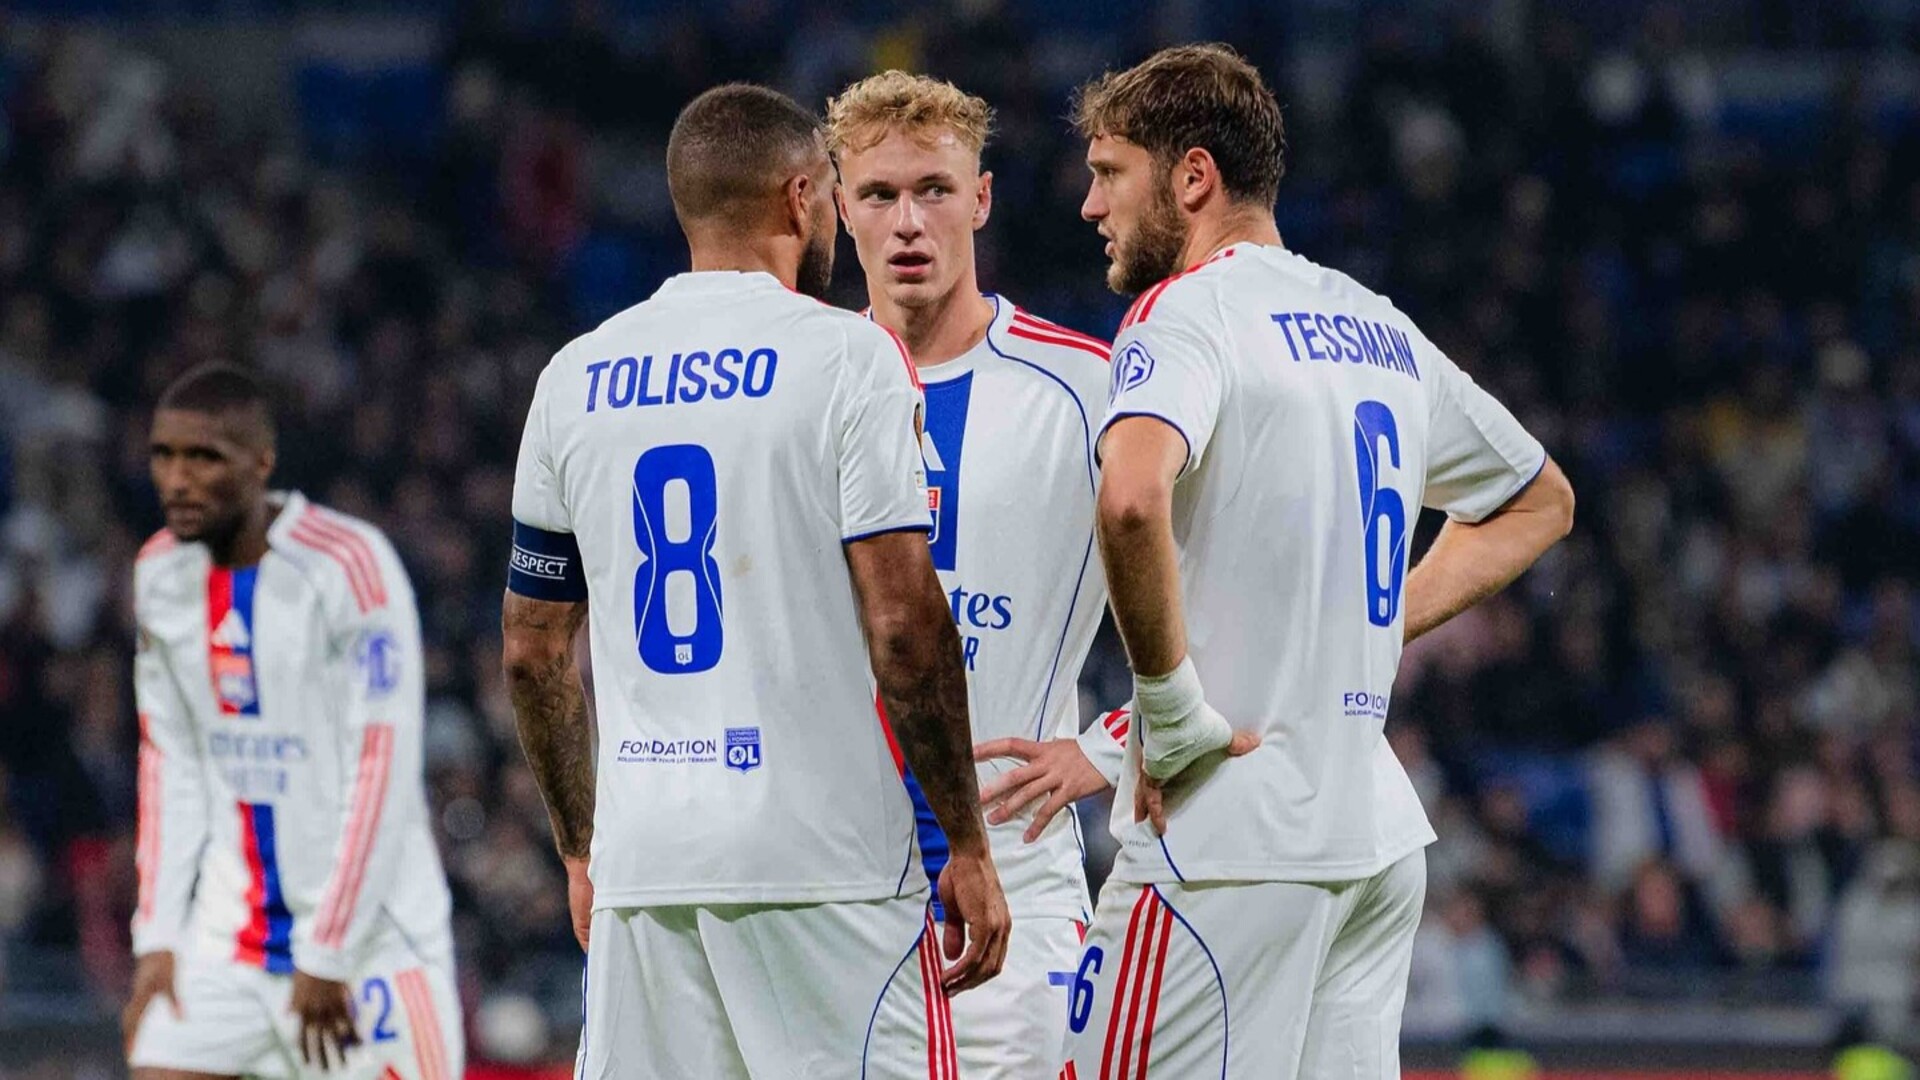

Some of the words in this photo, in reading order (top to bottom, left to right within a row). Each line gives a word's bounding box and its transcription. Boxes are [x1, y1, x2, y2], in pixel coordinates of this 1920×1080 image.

[586, 347, 778, 412] TOLISSO
[1270, 312, 1420, 381] TESSMANN
[1354, 400, 1406, 627] 6
[632, 444, 724, 674] 8
[948, 584, 1012, 630] tes
[619, 739, 717, 756] FONDATION
[729, 745, 759, 766] OL
[352, 977, 398, 1043] 2
[1069, 945, 1104, 1034] 6
